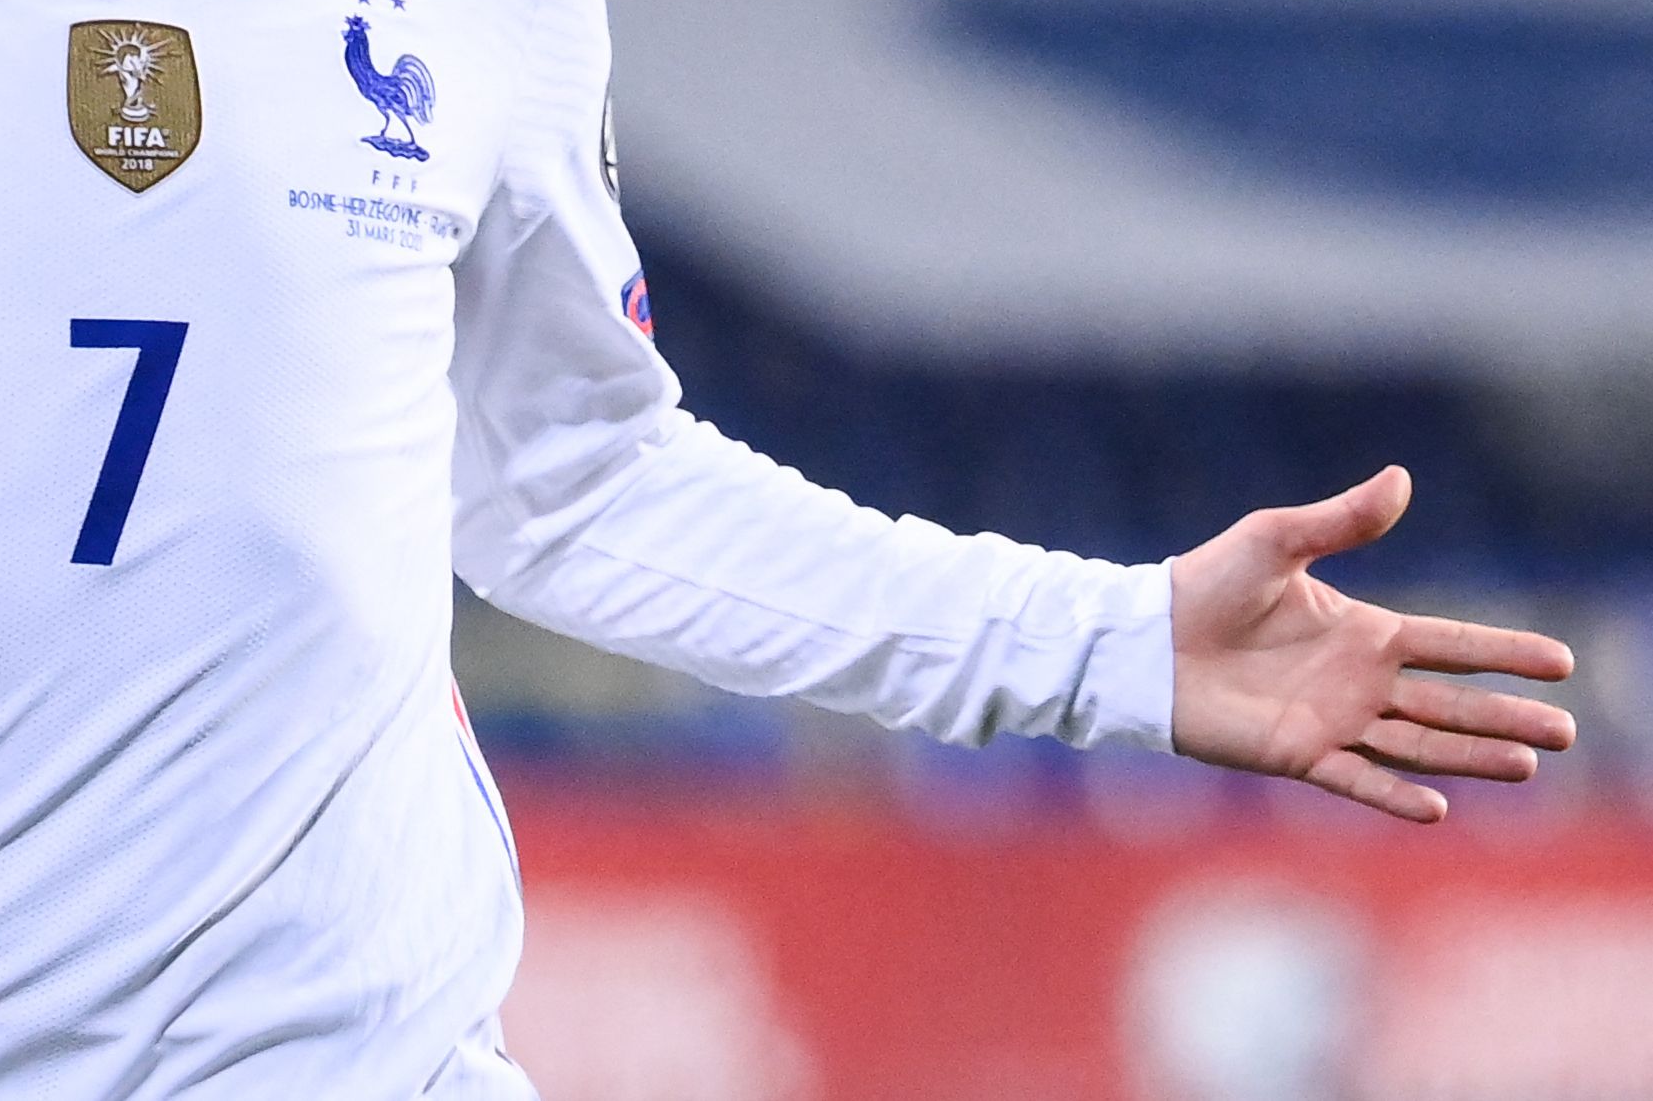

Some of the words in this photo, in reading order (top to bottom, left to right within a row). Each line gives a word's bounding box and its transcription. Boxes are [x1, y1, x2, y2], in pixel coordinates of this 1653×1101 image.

[108, 126, 166, 148] FIFA
[121, 158, 154, 171] 2018
[346, 219, 360, 238] 31
[70, 318, 190, 566] 7
